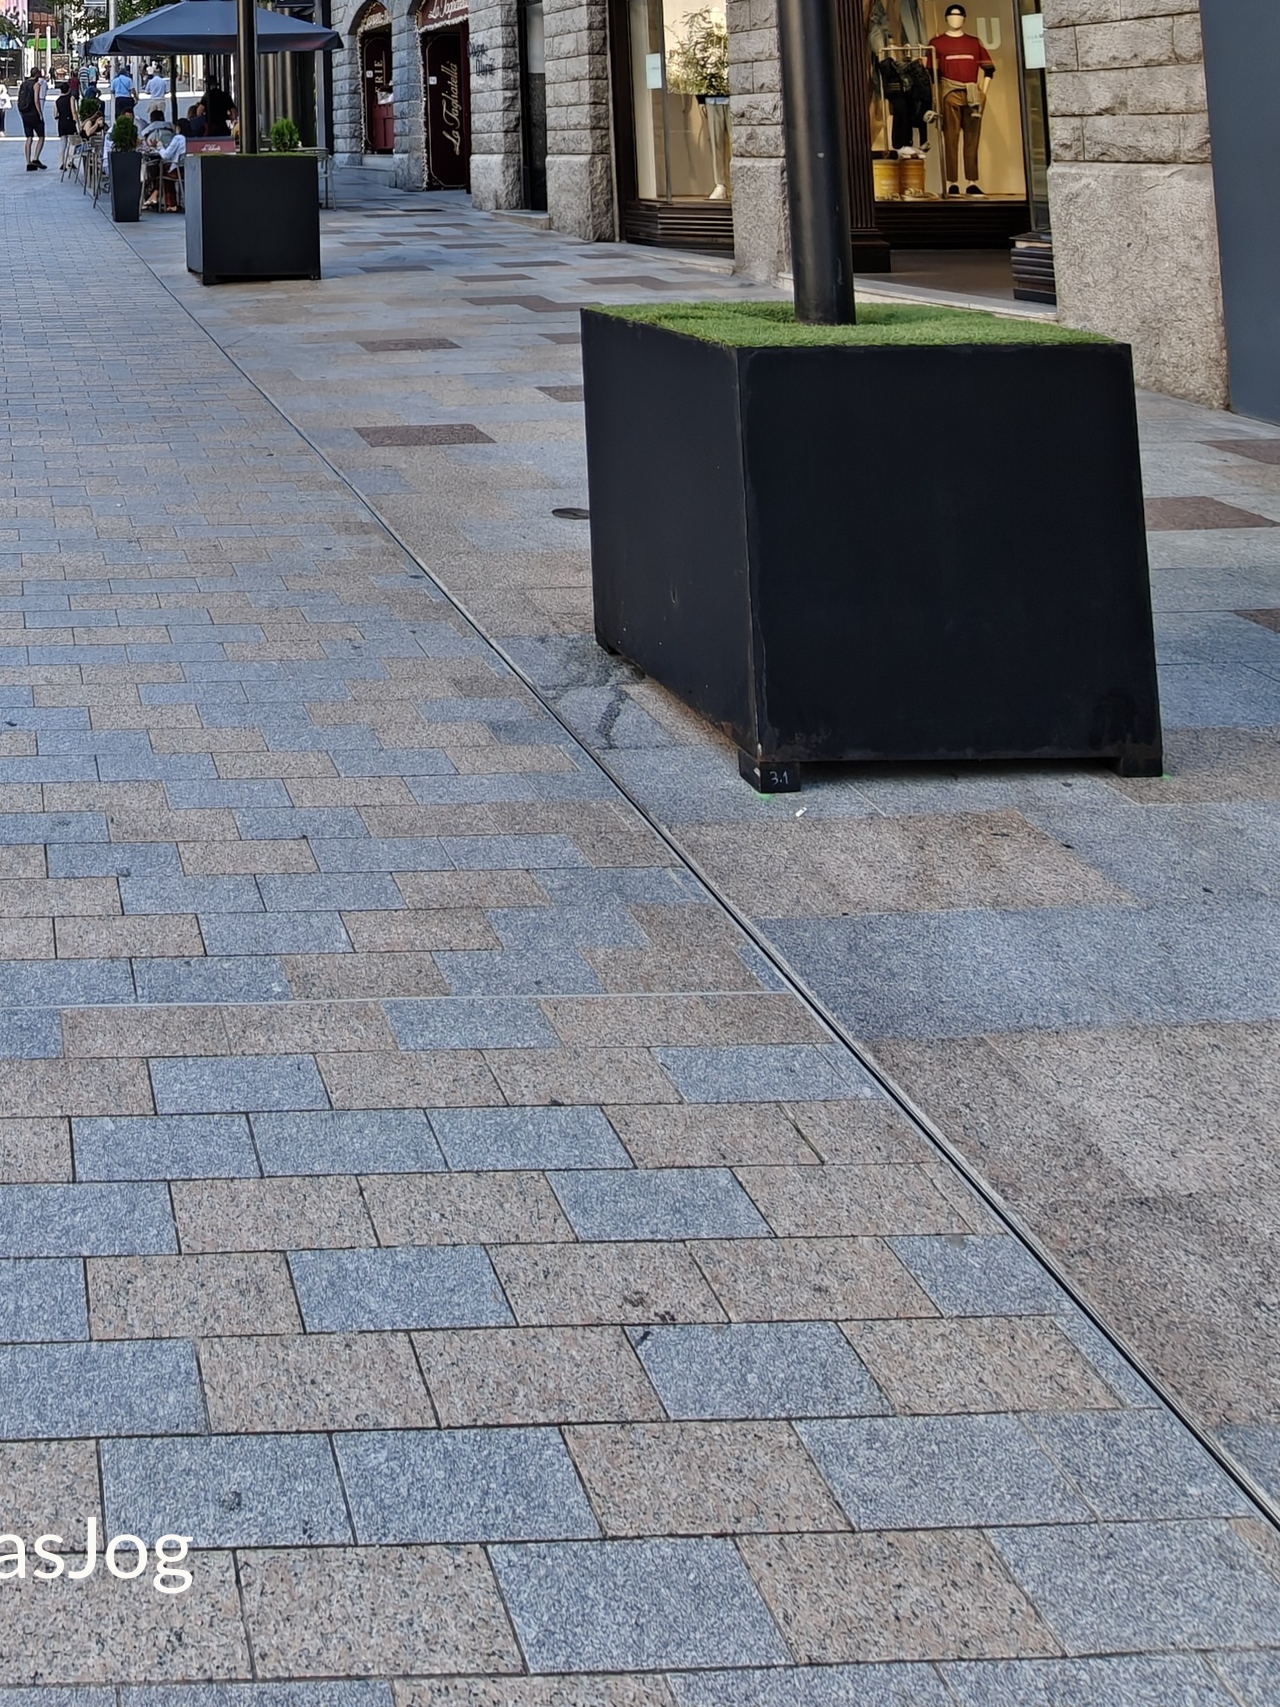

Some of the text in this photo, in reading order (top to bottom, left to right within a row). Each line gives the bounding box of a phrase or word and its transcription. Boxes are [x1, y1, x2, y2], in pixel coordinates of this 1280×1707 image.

[440, 63, 462, 156] La Tagliatella
[769, 770, 789, 786] 3.1
